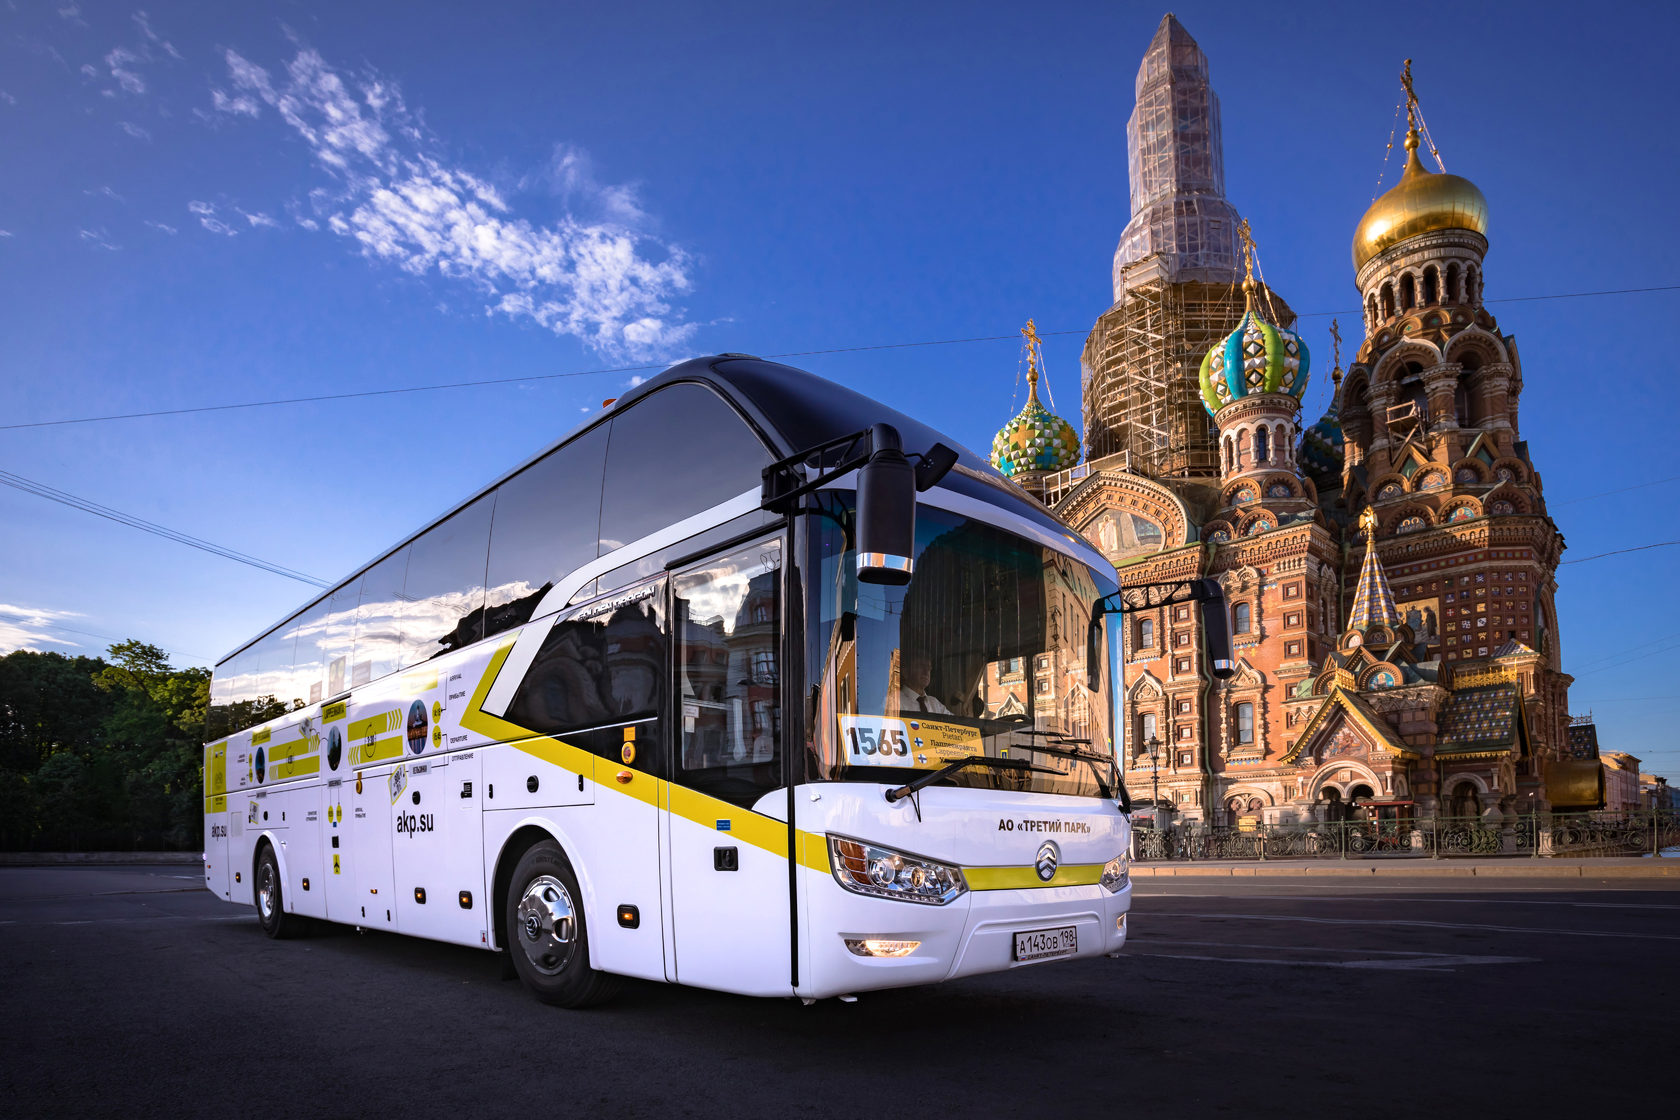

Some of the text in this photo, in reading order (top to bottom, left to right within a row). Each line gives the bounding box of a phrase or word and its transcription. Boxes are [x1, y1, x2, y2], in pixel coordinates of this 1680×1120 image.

[614, 586, 655, 609] DRAGON
[921, 722, 978, 737] Санкт-Петербург
[846, 727, 908, 757] 1565
[396, 810, 434, 839] akp.su
[998, 819, 1091, 834] АО «ТРЕТИЙ ПАРК»
[1060, 930, 1074, 945] 198
